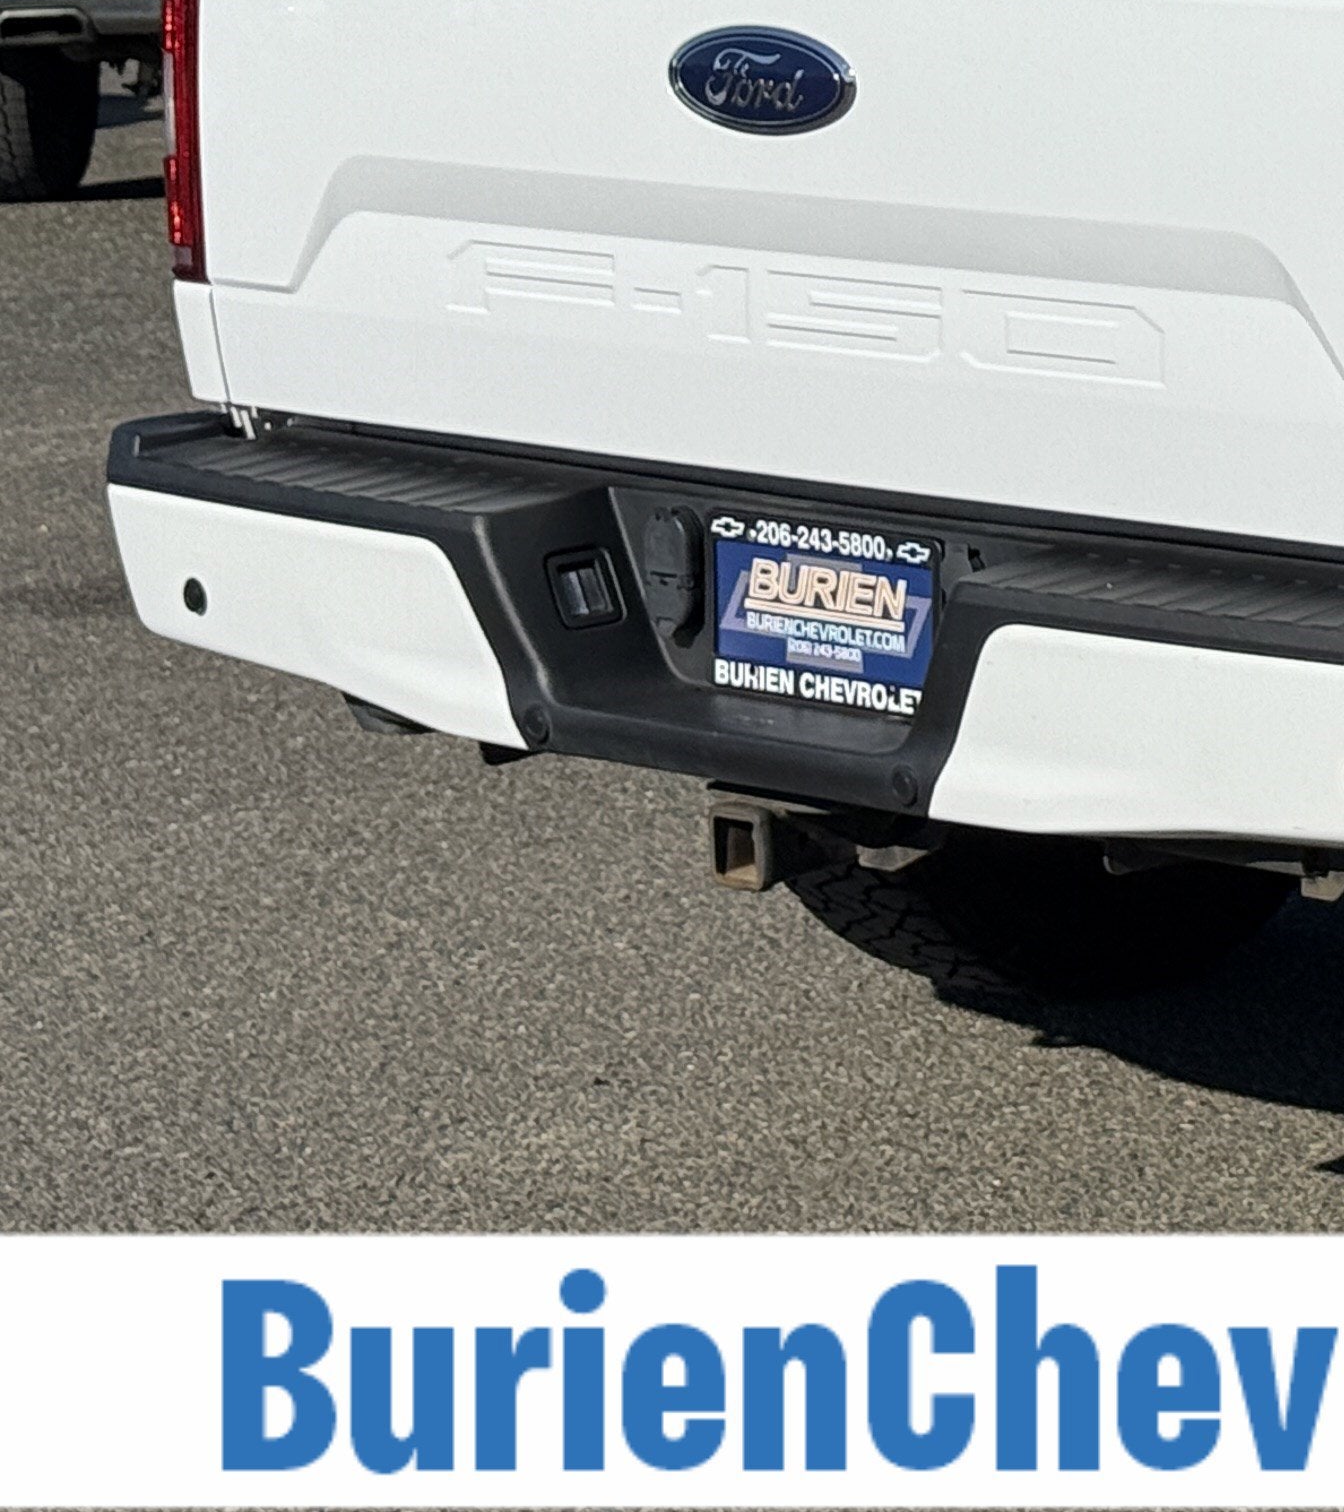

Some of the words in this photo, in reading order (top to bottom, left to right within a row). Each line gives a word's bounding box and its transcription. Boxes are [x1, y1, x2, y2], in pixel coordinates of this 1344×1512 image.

[705, 47, 805, 113] Ford
[446, 240, 1166, 389] F-150
[756, 519, 886, 561] 206-243-5800
[748, 557, 908, 620] BURIEN
[746, 611, 906, 653] BURIENCHEVROLET.COM
[714, 658, 795, 696] BURIEN
